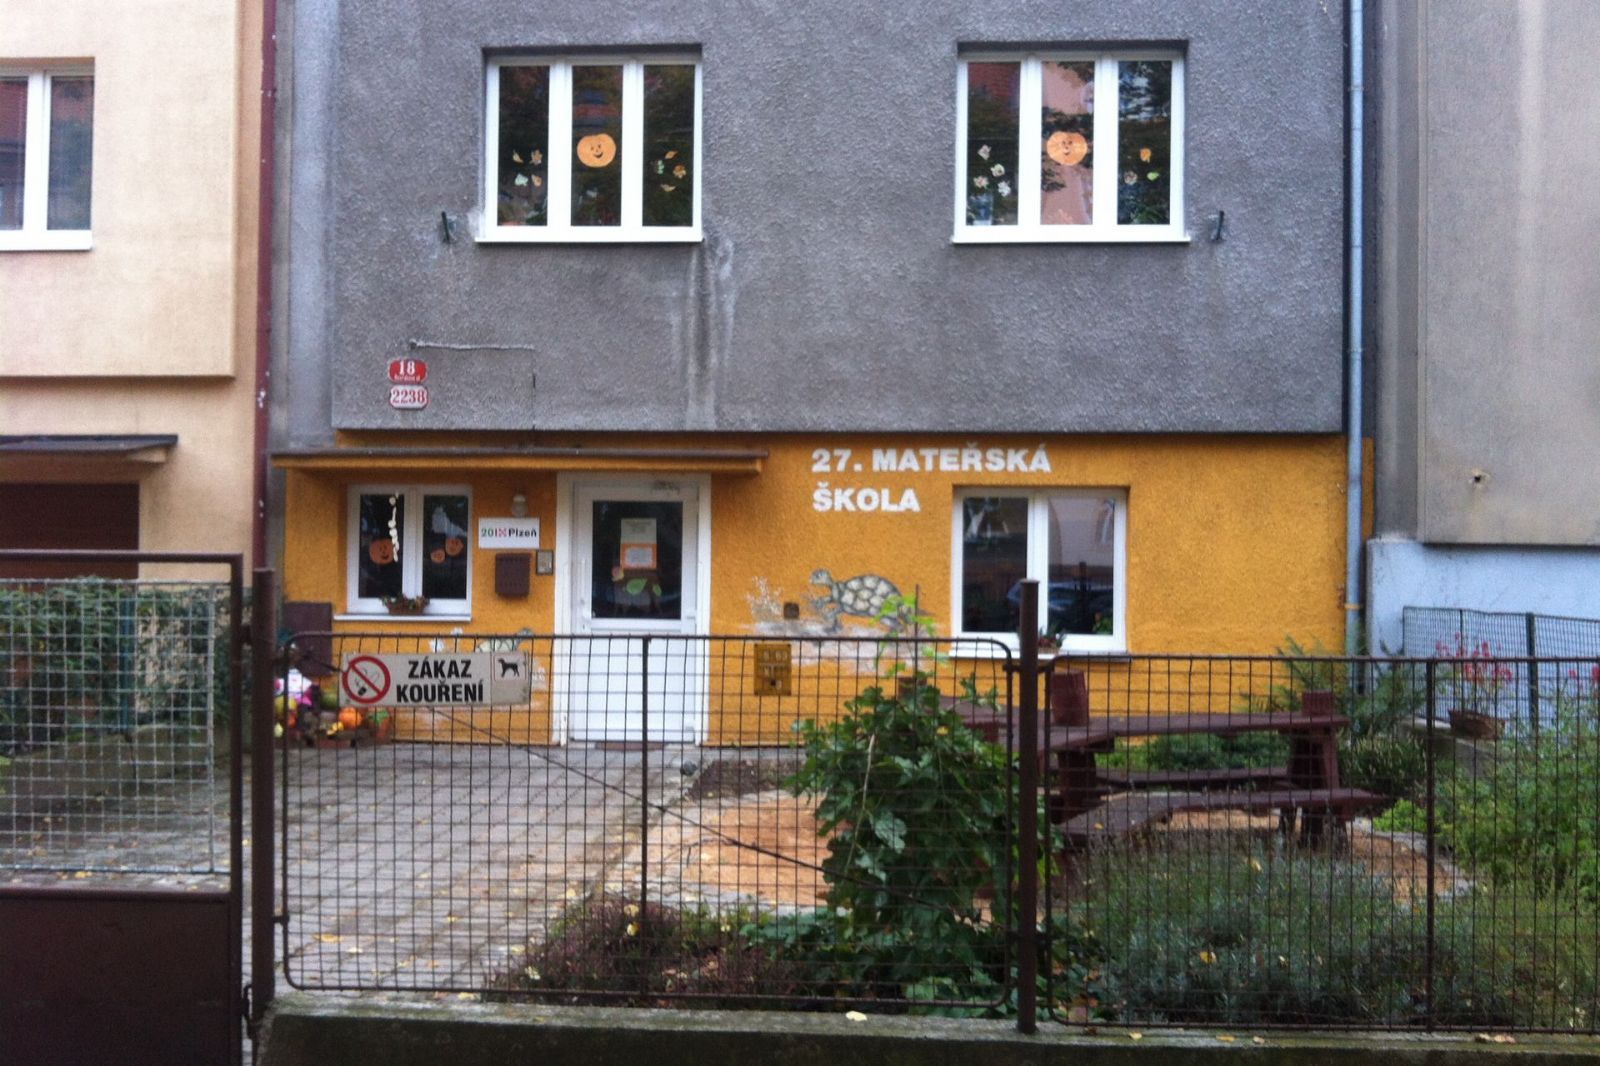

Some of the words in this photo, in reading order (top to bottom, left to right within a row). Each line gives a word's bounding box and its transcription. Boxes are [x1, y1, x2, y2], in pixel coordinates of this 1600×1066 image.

[399, 360, 416, 376] 18
[392, 388, 425, 404] 2238
[811, 448, 863, 473] 27.
[872, 441, 1052, 473] MATEŘSKÁ
[812, 481, 921, 513] ŠKOLA
[408, 656, 472, 679] ZÁKAZ
[396, 679, 484, 703] KOUŘENÍ
